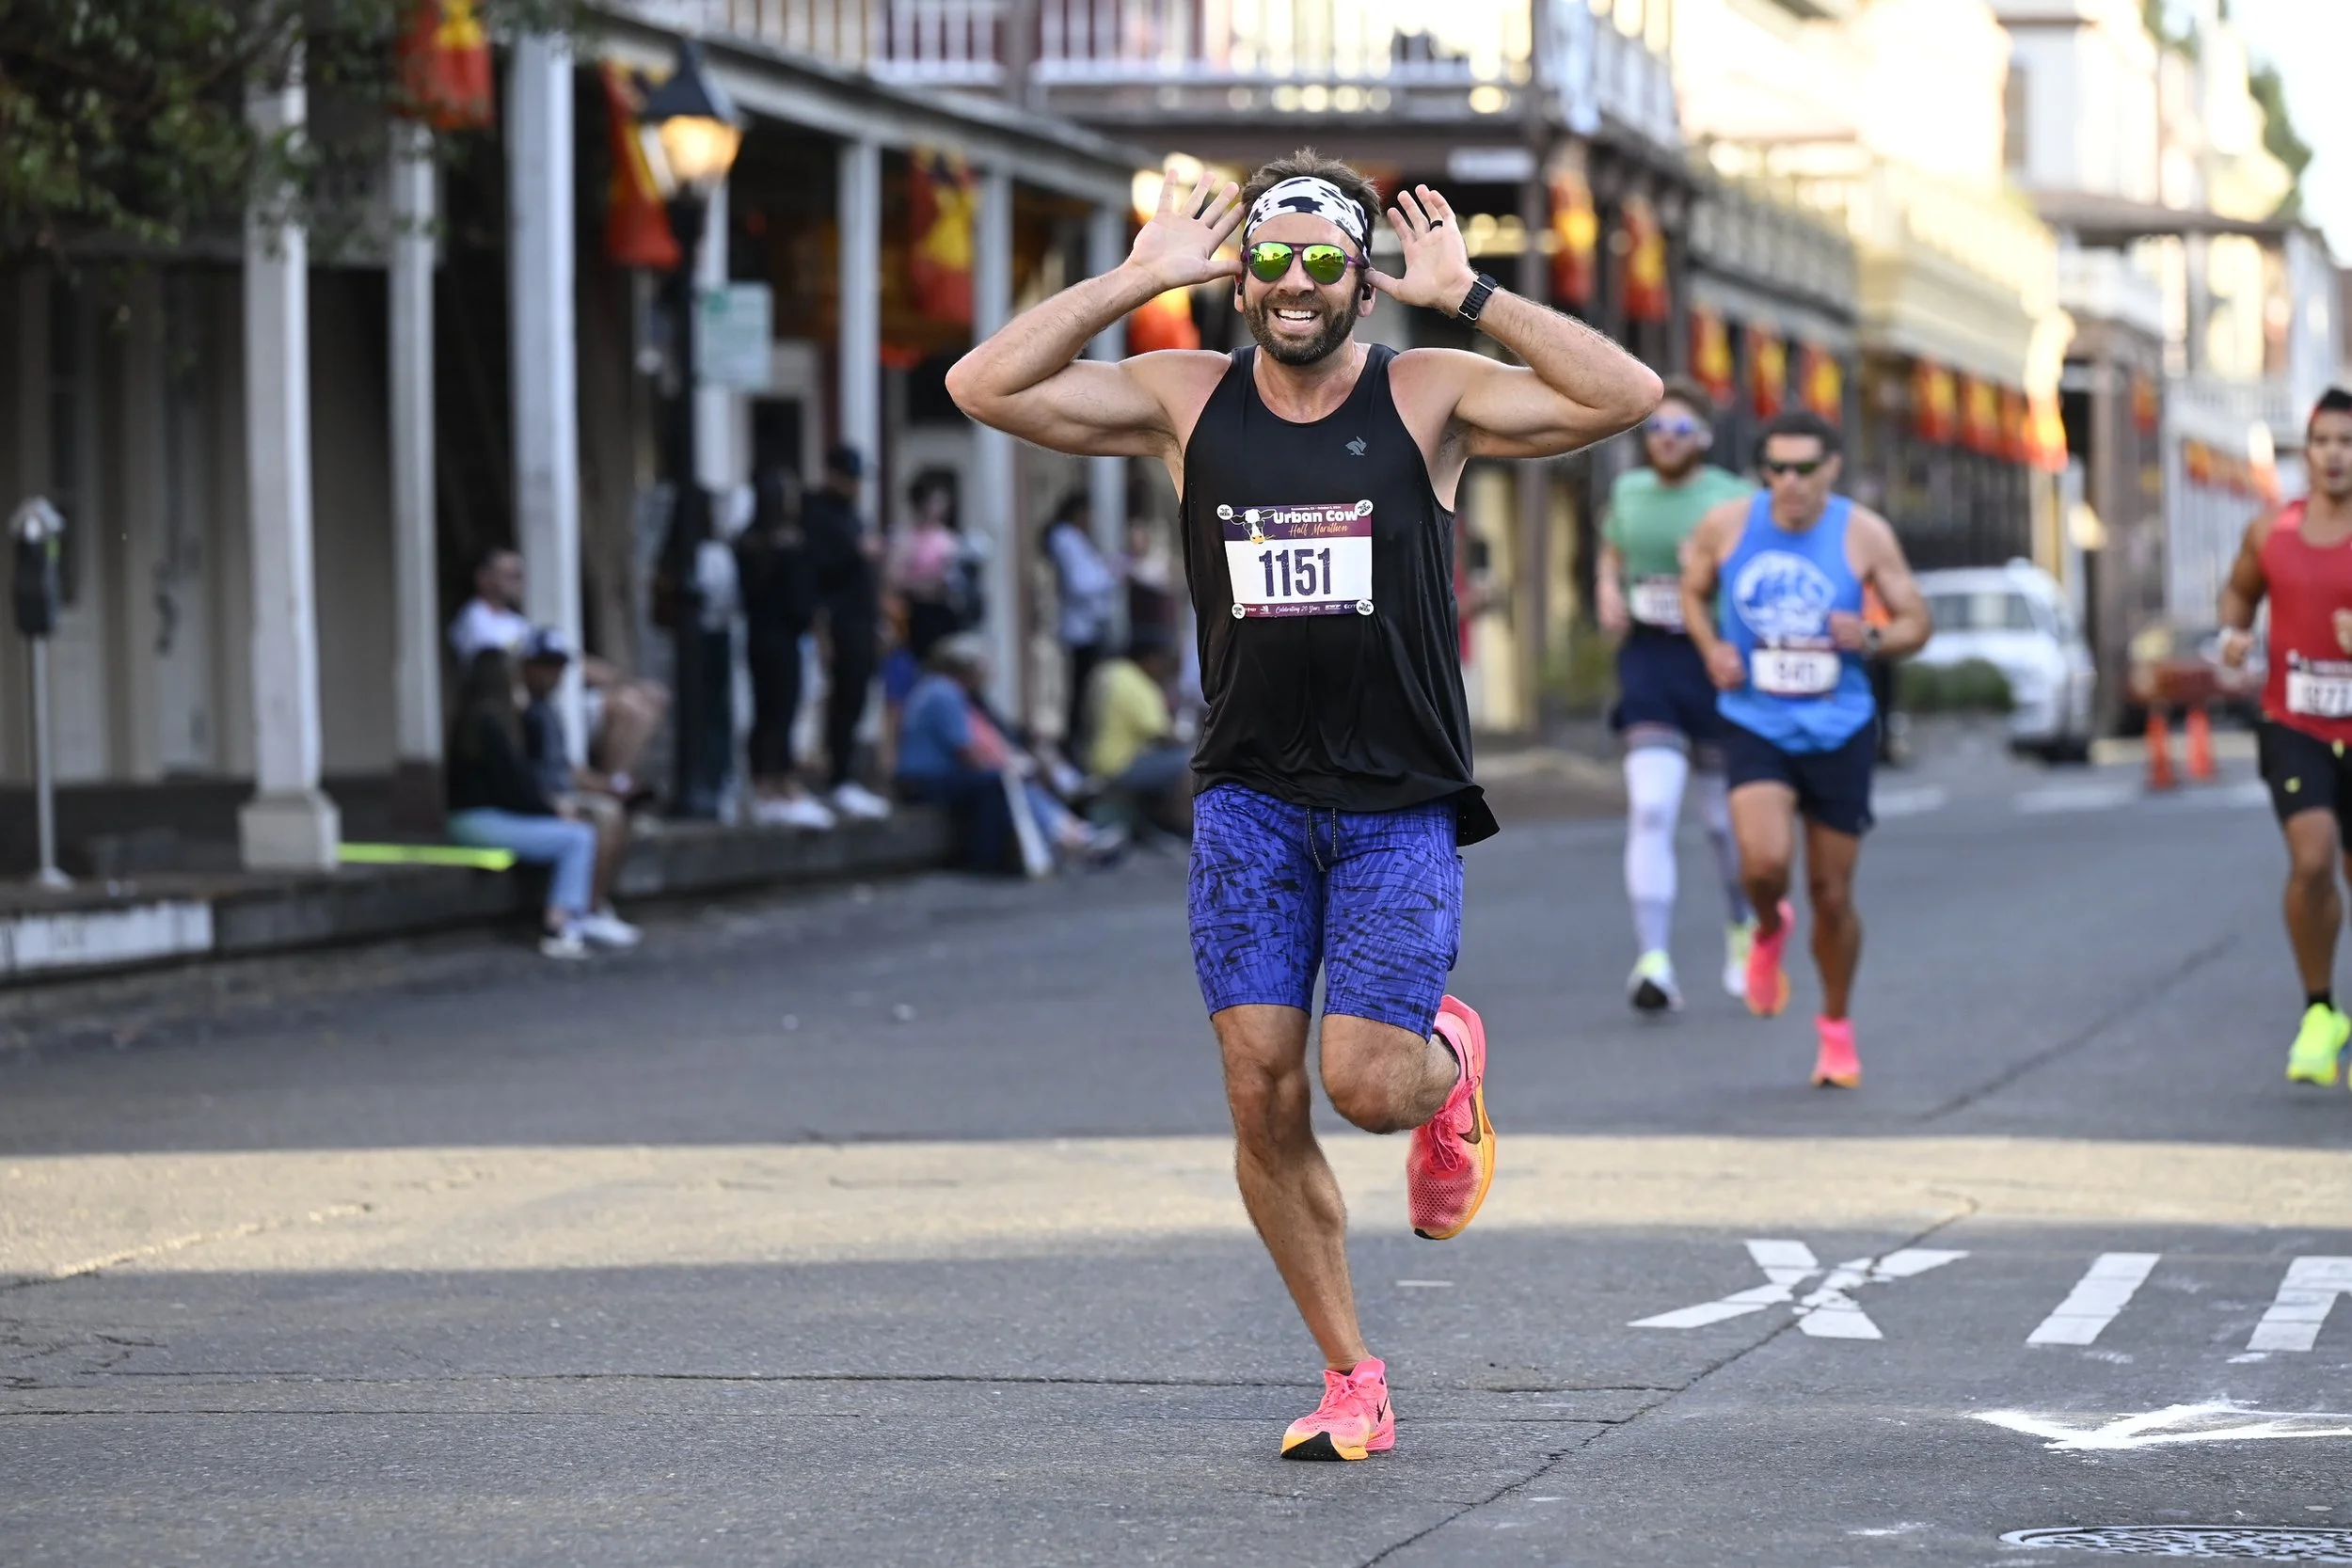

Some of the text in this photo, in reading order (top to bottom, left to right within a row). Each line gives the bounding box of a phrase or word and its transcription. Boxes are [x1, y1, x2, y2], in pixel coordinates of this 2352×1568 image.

[1273, 510, 1358, 524] Urban Cow
[1288, 523, 1348, 537] Half Marathon
[1259, 547, 1331, 597] 1151
